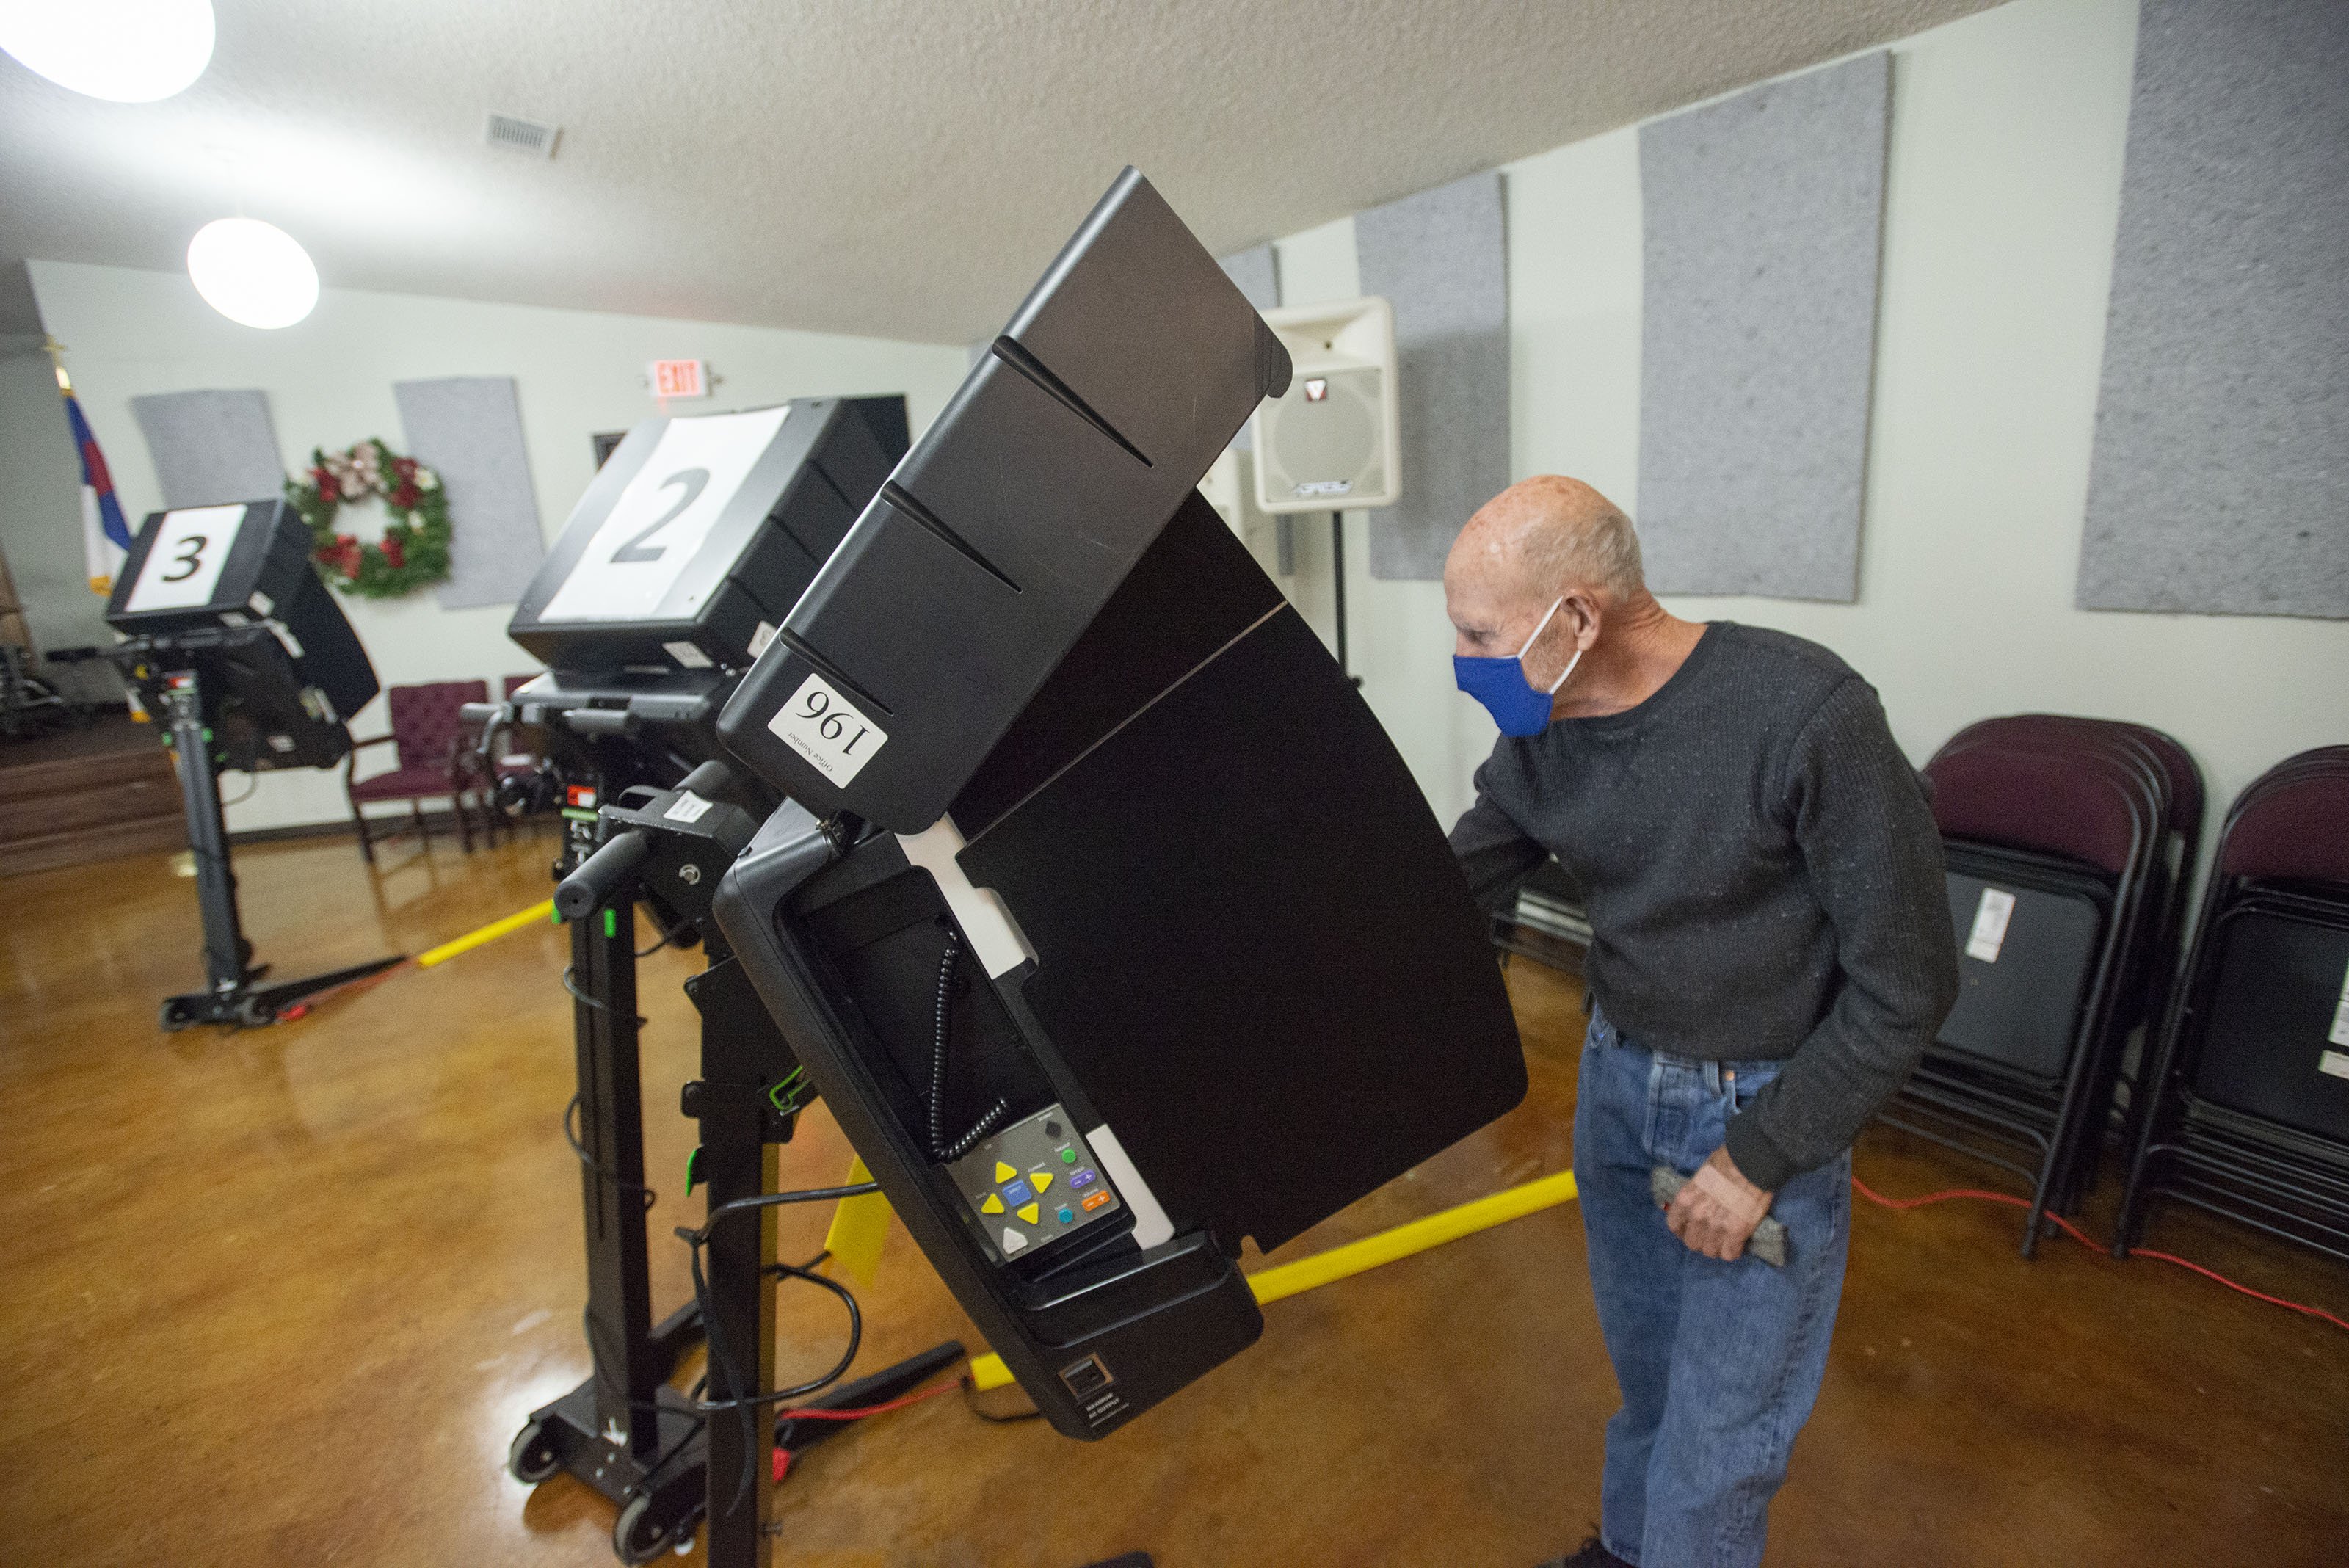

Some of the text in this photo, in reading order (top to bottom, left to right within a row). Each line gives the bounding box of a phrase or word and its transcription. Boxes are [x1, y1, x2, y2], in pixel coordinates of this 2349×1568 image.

[658, 362, 697, 394] EXIT
[609, 466, 711, 563] 2
[161, 535, 208, 582] 3
[795, 691, 870, 756] 196
[787, 731, 834, 773] Office Number
